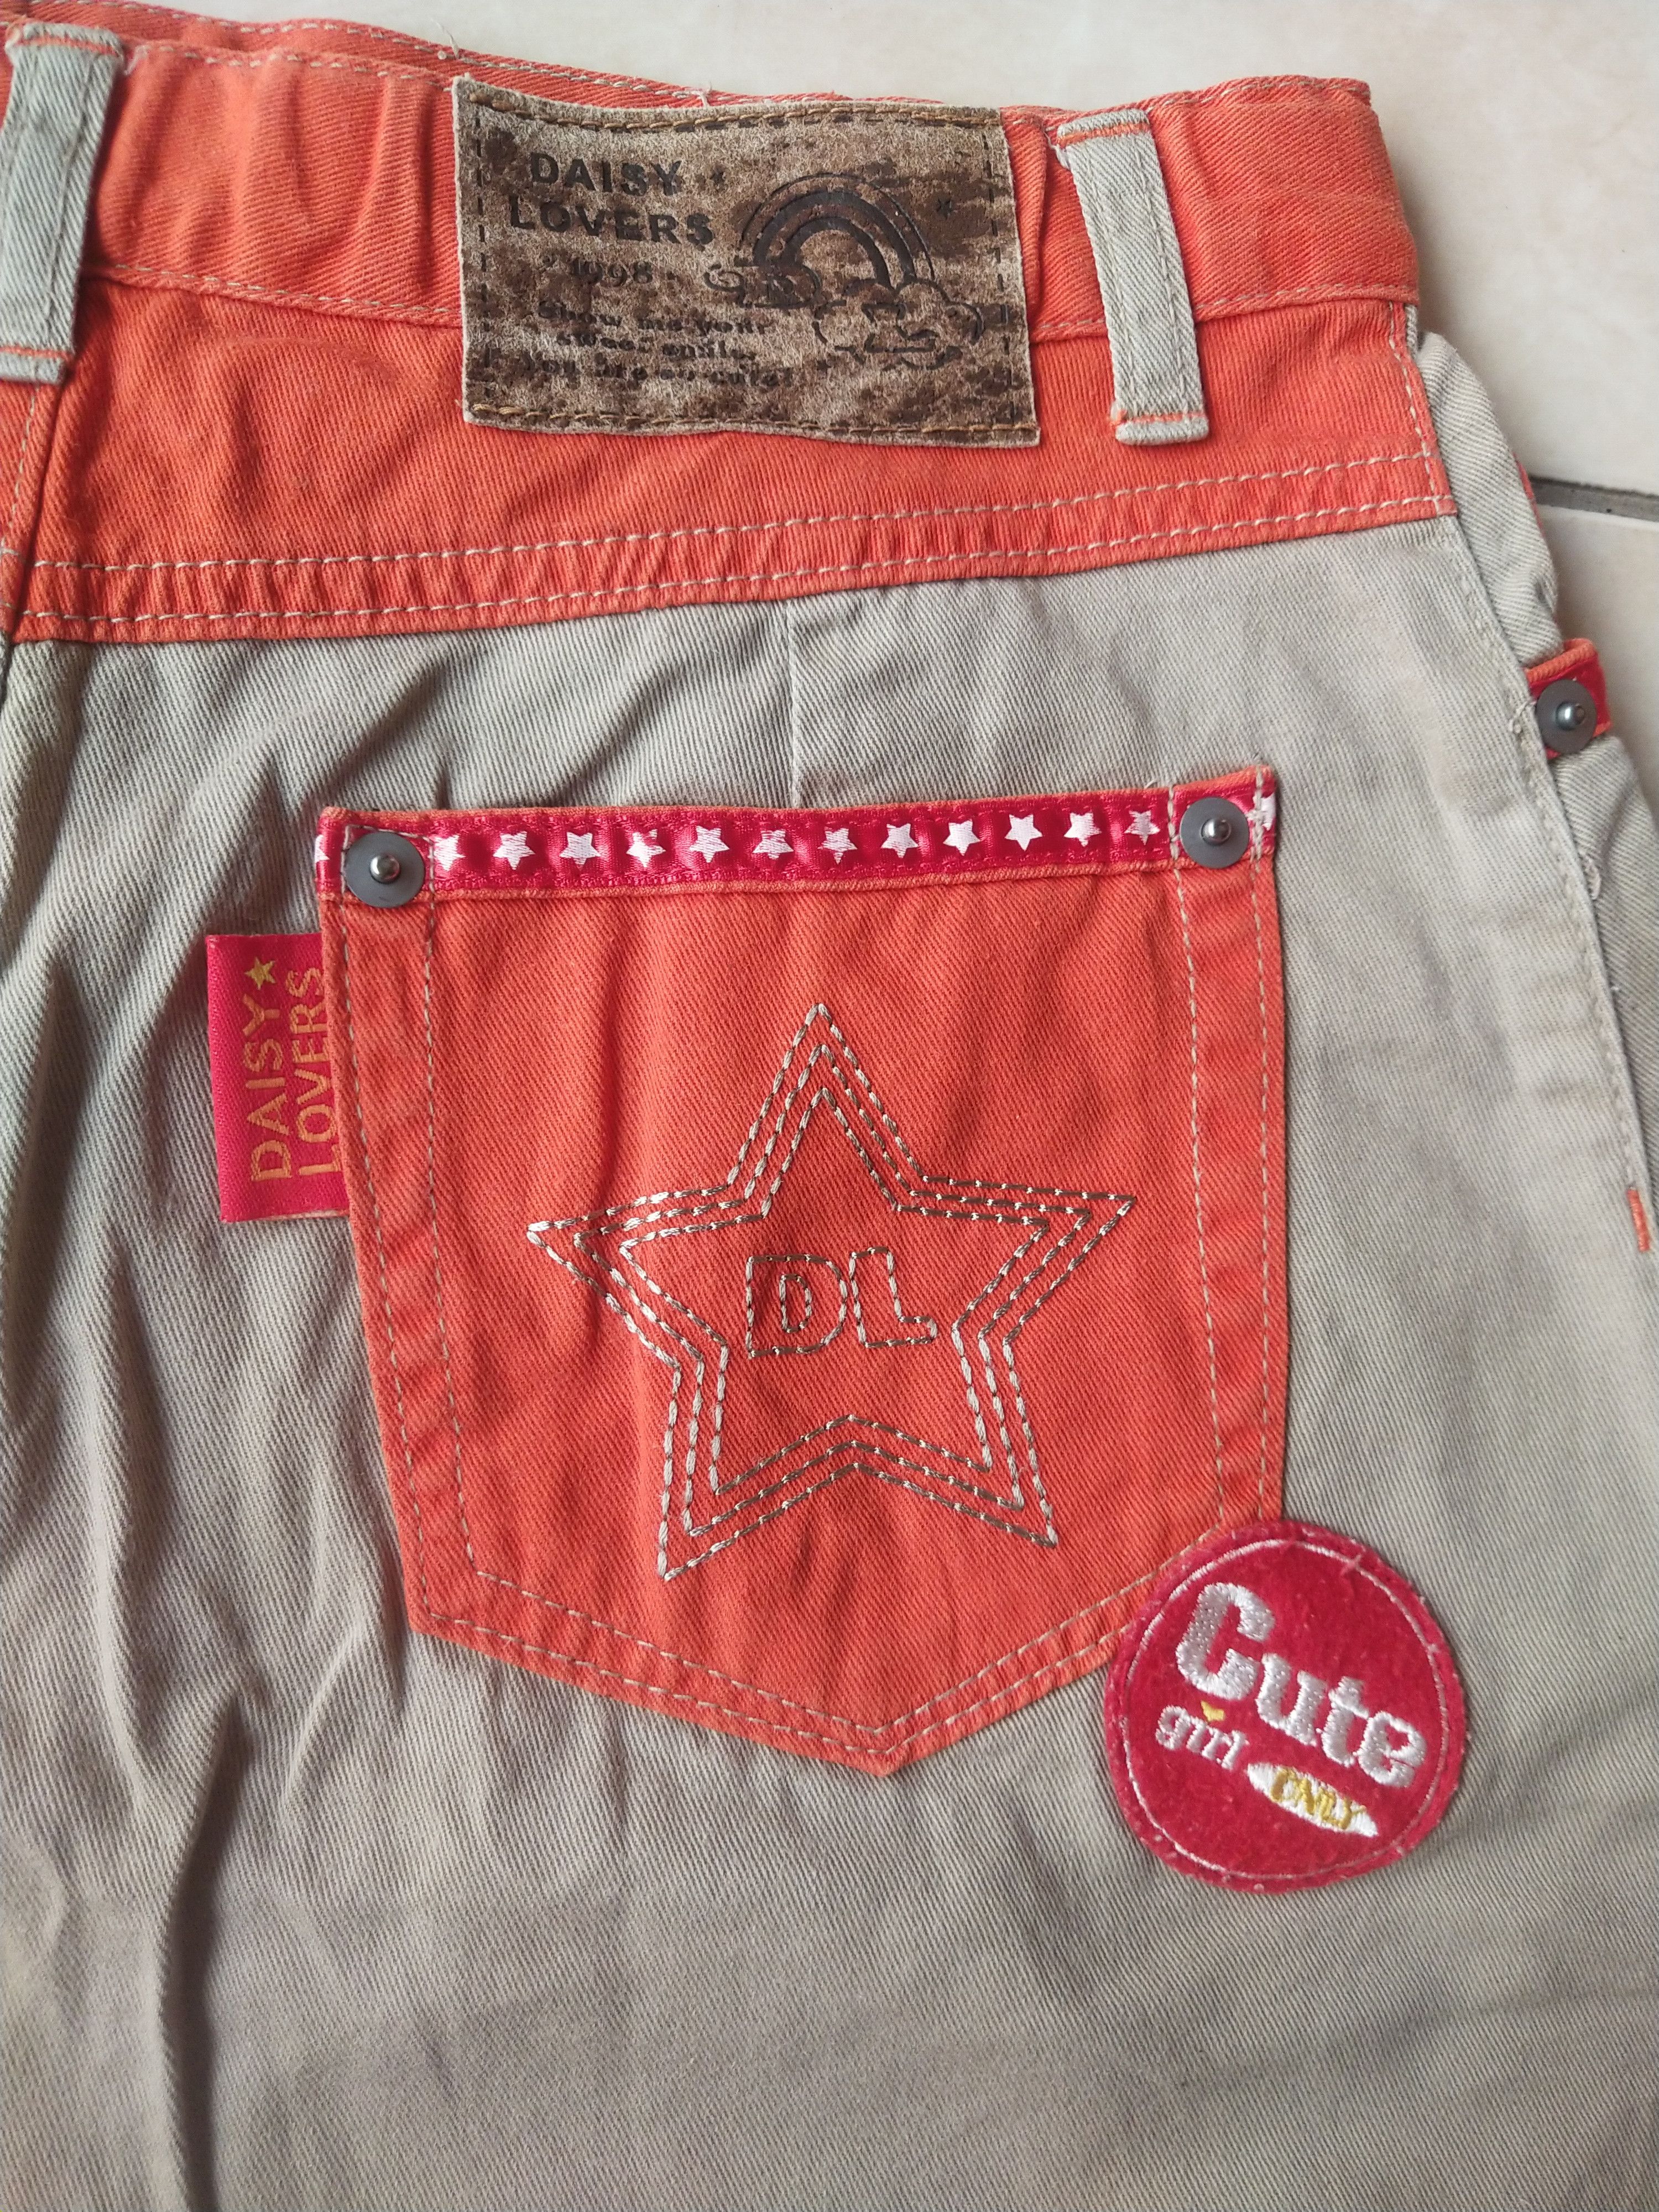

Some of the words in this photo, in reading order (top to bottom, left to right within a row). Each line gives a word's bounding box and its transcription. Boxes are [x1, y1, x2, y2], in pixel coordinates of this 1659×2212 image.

[509, 195, 714, 247] LOVERS
[531, 152, 682, 196] DAISY
[242, 993, 293, 1182] DAISY
[285, 966, 342, 1176] LOVERS
[745, 1246, 939, 1359] DL
[1155, 1701, 1250, 1768] girl
[1175, 1582, 1428, 1789] Cute
